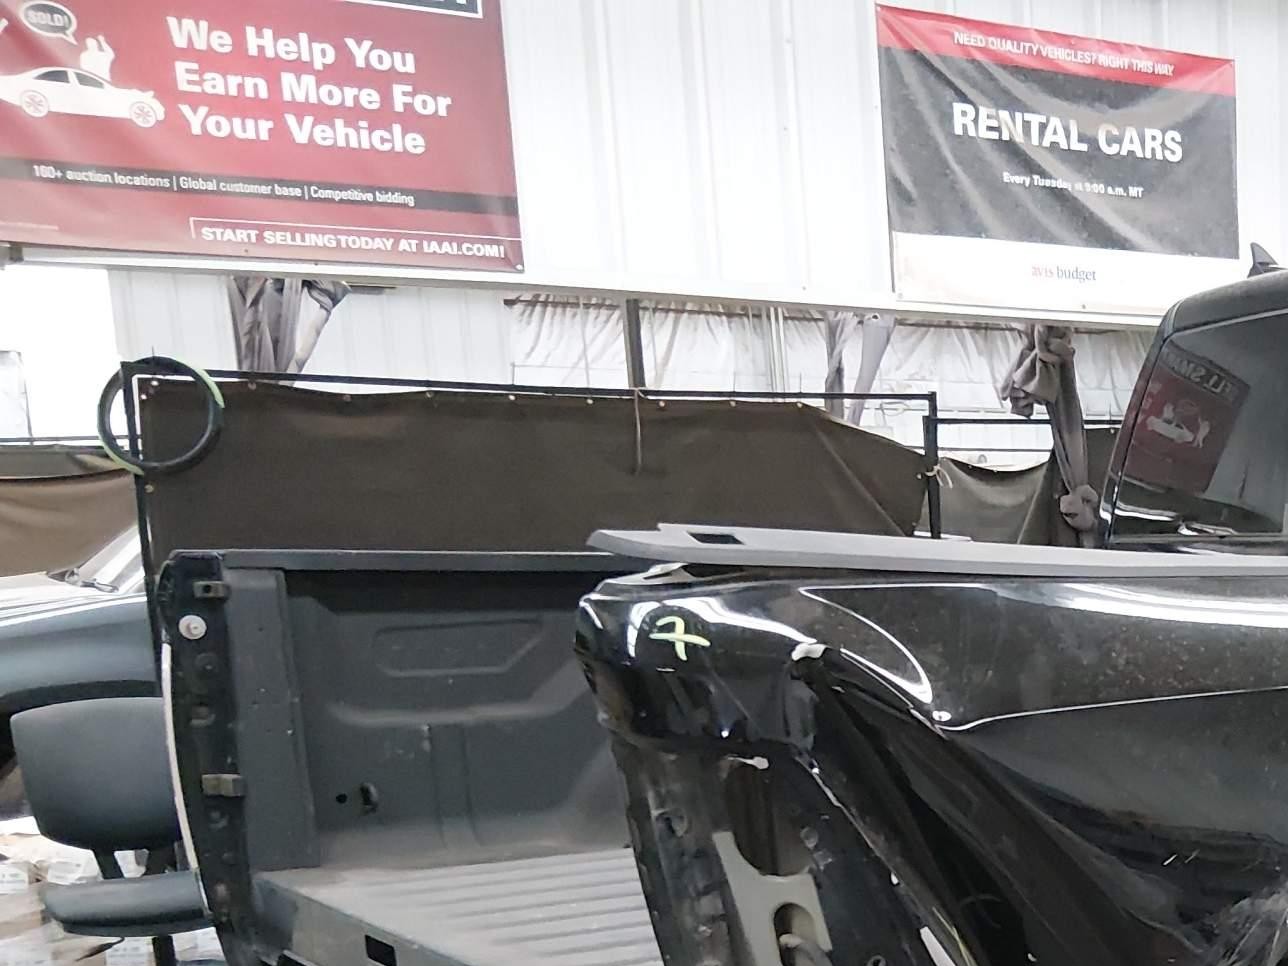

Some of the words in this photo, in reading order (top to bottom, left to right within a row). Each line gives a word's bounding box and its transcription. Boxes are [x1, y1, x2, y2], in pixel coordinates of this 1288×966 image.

[28, 10, 68, 27] SOLD!
[166, 16, 233, 53] We
[245, 25, 336, 70] Help
[344, 38, 416, 73] You
[954, 31, 986, 48] NEED
[988, 36, 1038, 56] QUALITY
[1040, 47, 1095, 65] VEHICLES?
[1098, 54, 1130, 70] RIGHT
[1131, 58, 1153, 74] THIS
[1154, 63, 1175, 77] WAY
[174, 61, 268, 99] Earn
[280, 72, 381, 109] More
[392, 84, 452, 117] For
[178, 104, 274, 141] Your
[284, 113, 426, 154] Vehicle
[952, 102, 1088, 152] RENTAL
[1098, 123, 1183, 163] CARS
[66, 170, 113, 184] auction
[114, 172, 170, 188] locations
[179, 176, 217, 191] Global
[219, 179, 272, 195] customer
[274, 182, 302, 197] base
[310, 186, 374, 202] Competitive
[375, 190, 415, 207] bidding
[1002, 171, 1030, 187] Every
[1032, 174, 1072, 191] Tuesday
[1107, 186, 1127, 196] a.m.
[1128, 186, 1144, 198] MT
[200, 227, 258, 244] START
[263, 230, 337, 248] SELLING
[337, 233, 394, 252] TODAY
[397, 238, 418, 253] AT
[422, 240, 505, 258] IAAI.COM!
[1031, 265, 1054, 279] avis
[1056, 265, 1097, 284] budget
